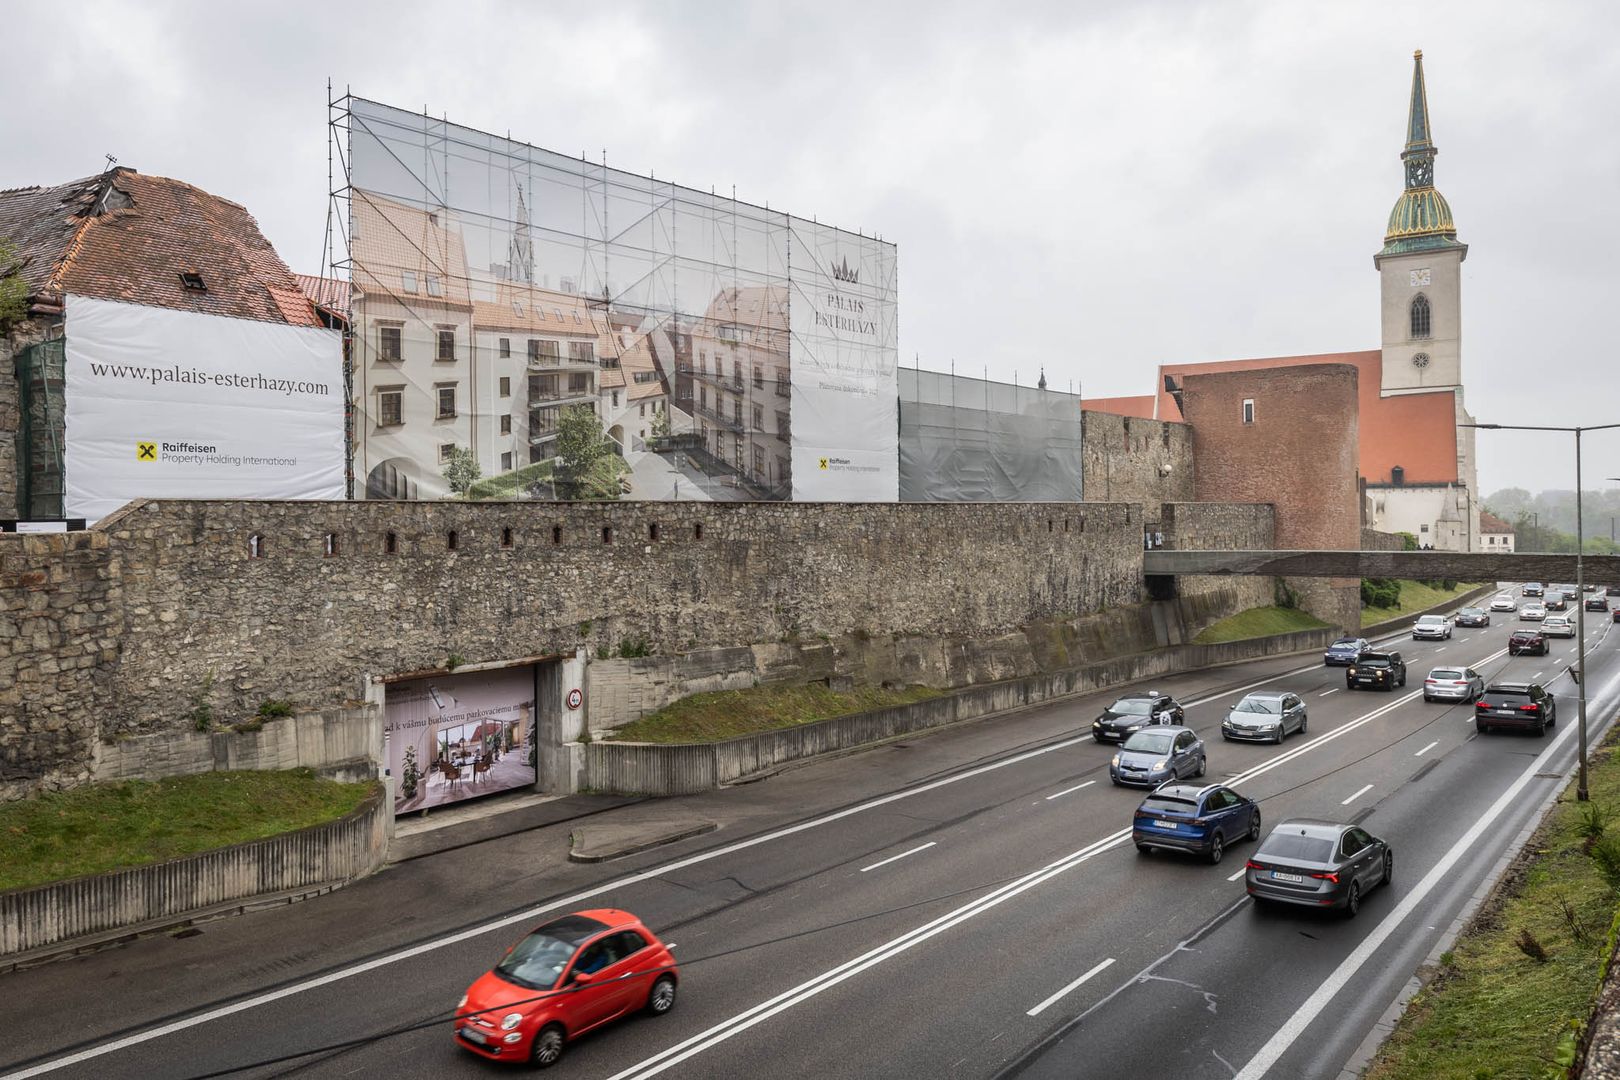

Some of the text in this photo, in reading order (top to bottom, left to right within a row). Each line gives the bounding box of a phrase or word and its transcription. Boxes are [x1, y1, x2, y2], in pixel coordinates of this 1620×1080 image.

[827, 293, 864, 313] PALAIS
[90, 363, 329, 395] www.palais-esterhazy.com
[162, 442, 216, 453] Raiffeisen
[162, 453, 297, 466] Property Holding International
[395, 721, 401, 730] k
[402, 719, 426, 730] vášmu
[428, 713, 465, 726] budúcemu
[466, 705, 511, 721] parkovaciemu
